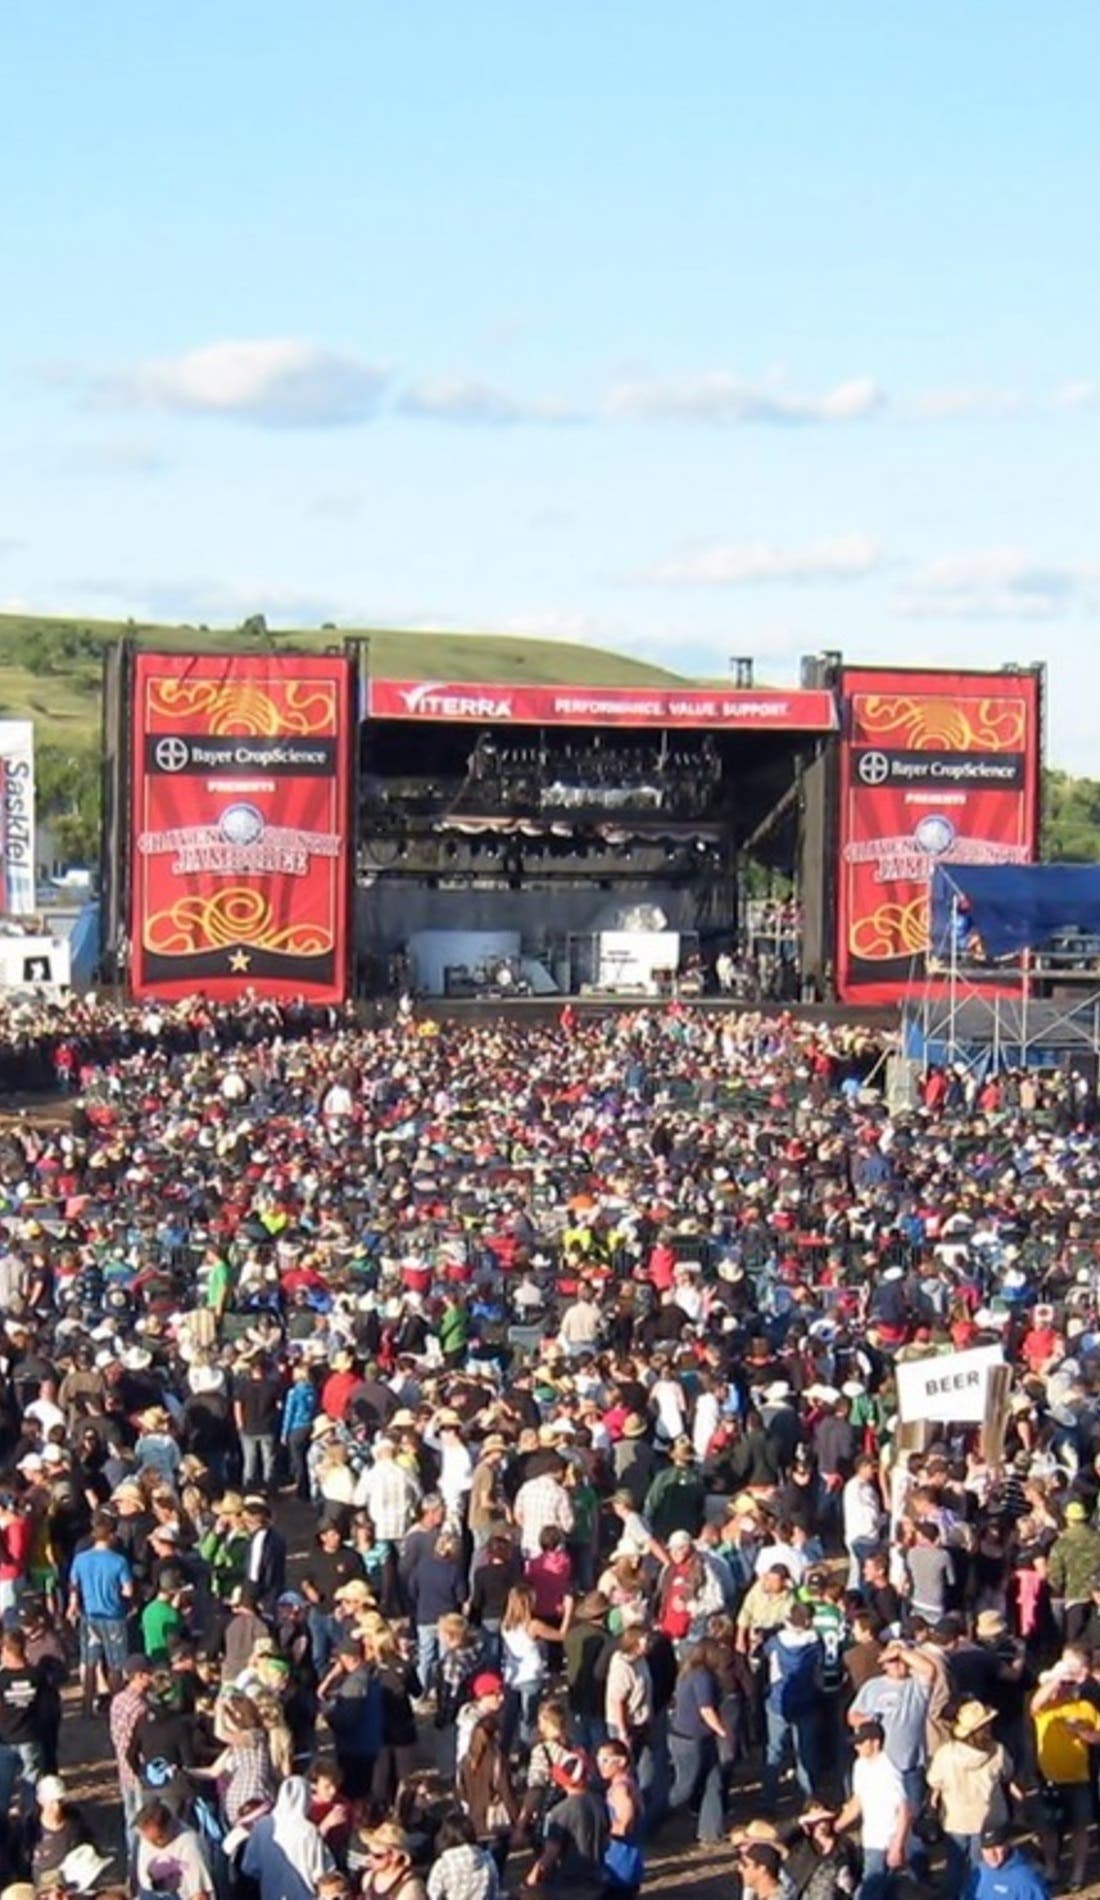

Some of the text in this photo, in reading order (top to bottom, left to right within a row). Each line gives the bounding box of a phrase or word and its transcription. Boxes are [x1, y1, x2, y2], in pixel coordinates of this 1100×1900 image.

[398, 683, 512, 717] VITERRA
[192, 747, 326, 767] Bayer CropScience
[891, 760, 1016, 780] Bayer CropScience
[5, 760, 29, 868] SaskTel
[925, 1370, 980, 1395] BEER
